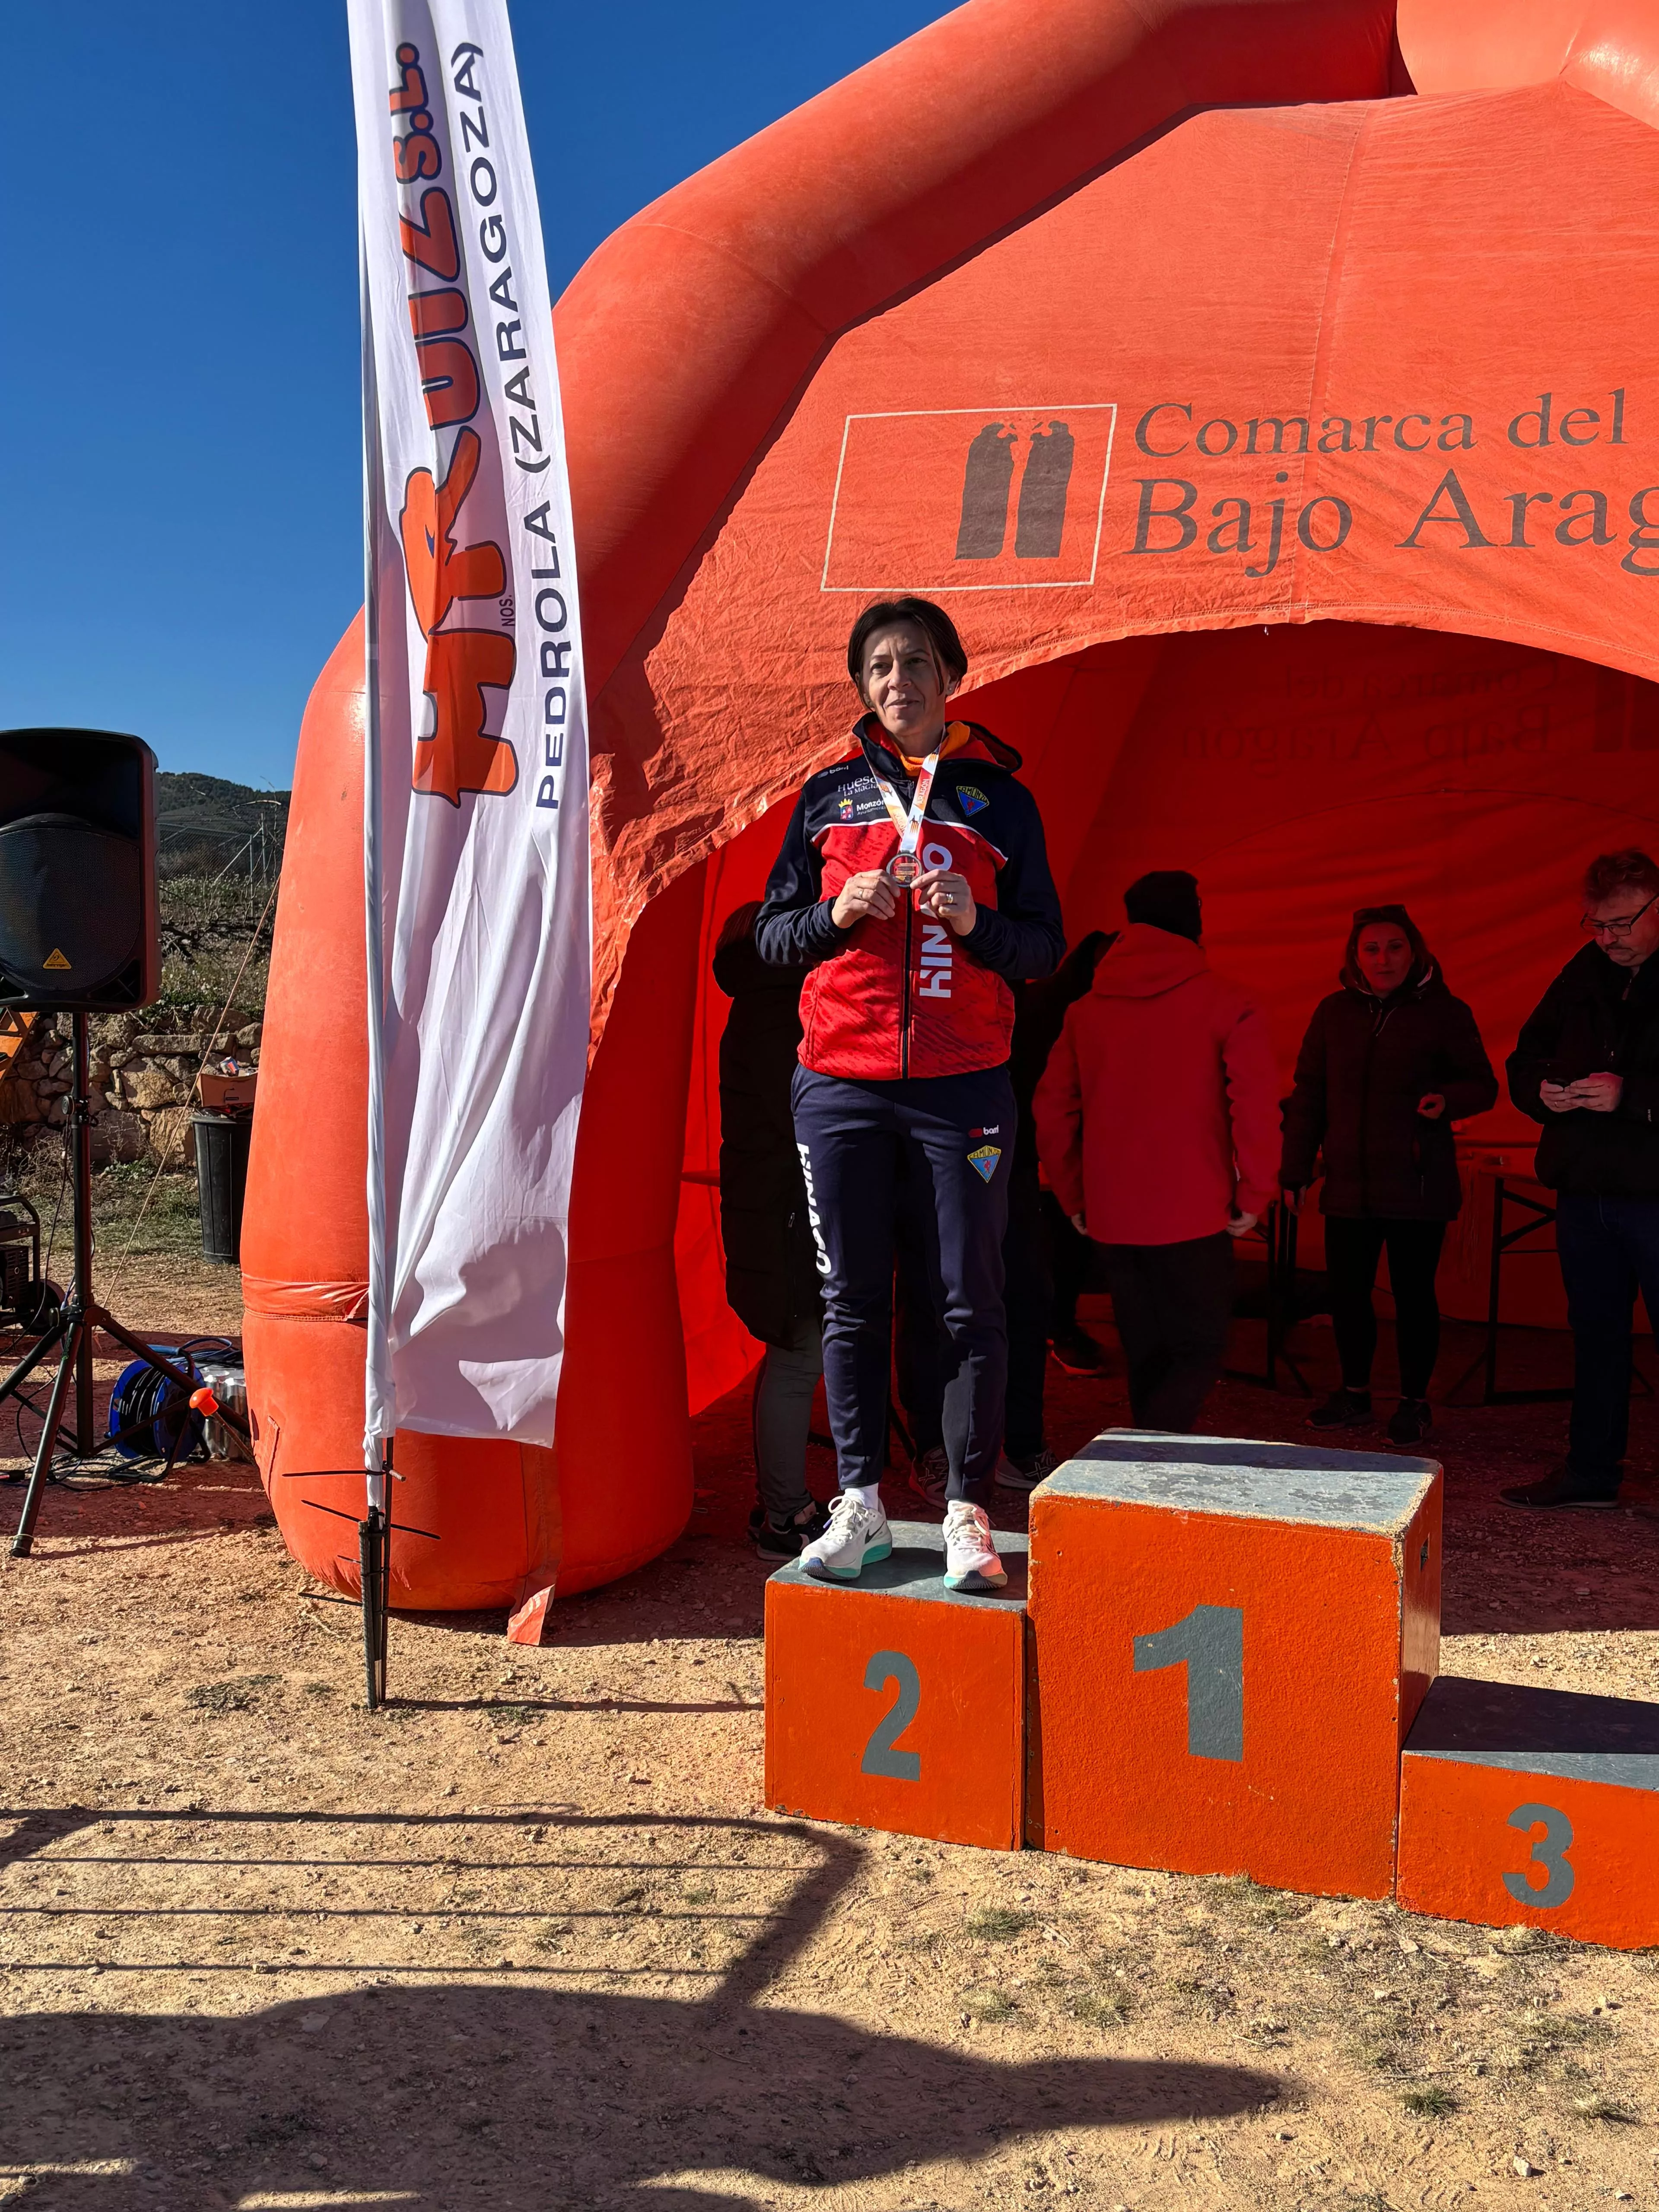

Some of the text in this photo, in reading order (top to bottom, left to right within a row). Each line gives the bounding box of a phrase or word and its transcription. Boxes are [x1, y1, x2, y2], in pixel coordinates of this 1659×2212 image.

[451, 41, 572, 810] PEDROLA (ZARAGOZA)
[1134, 387, 1629, 458] Comarca del
[1123, 471, 1353, 578] Bajo
[501, 594, 516, 627] NOS.
[919, 842, 953, 998] HINO
[861, 1650, 921, 1782] 2
[1133, 1602, 1244, 1762] 1
[1501, 1802, 1575, 1909] 3
